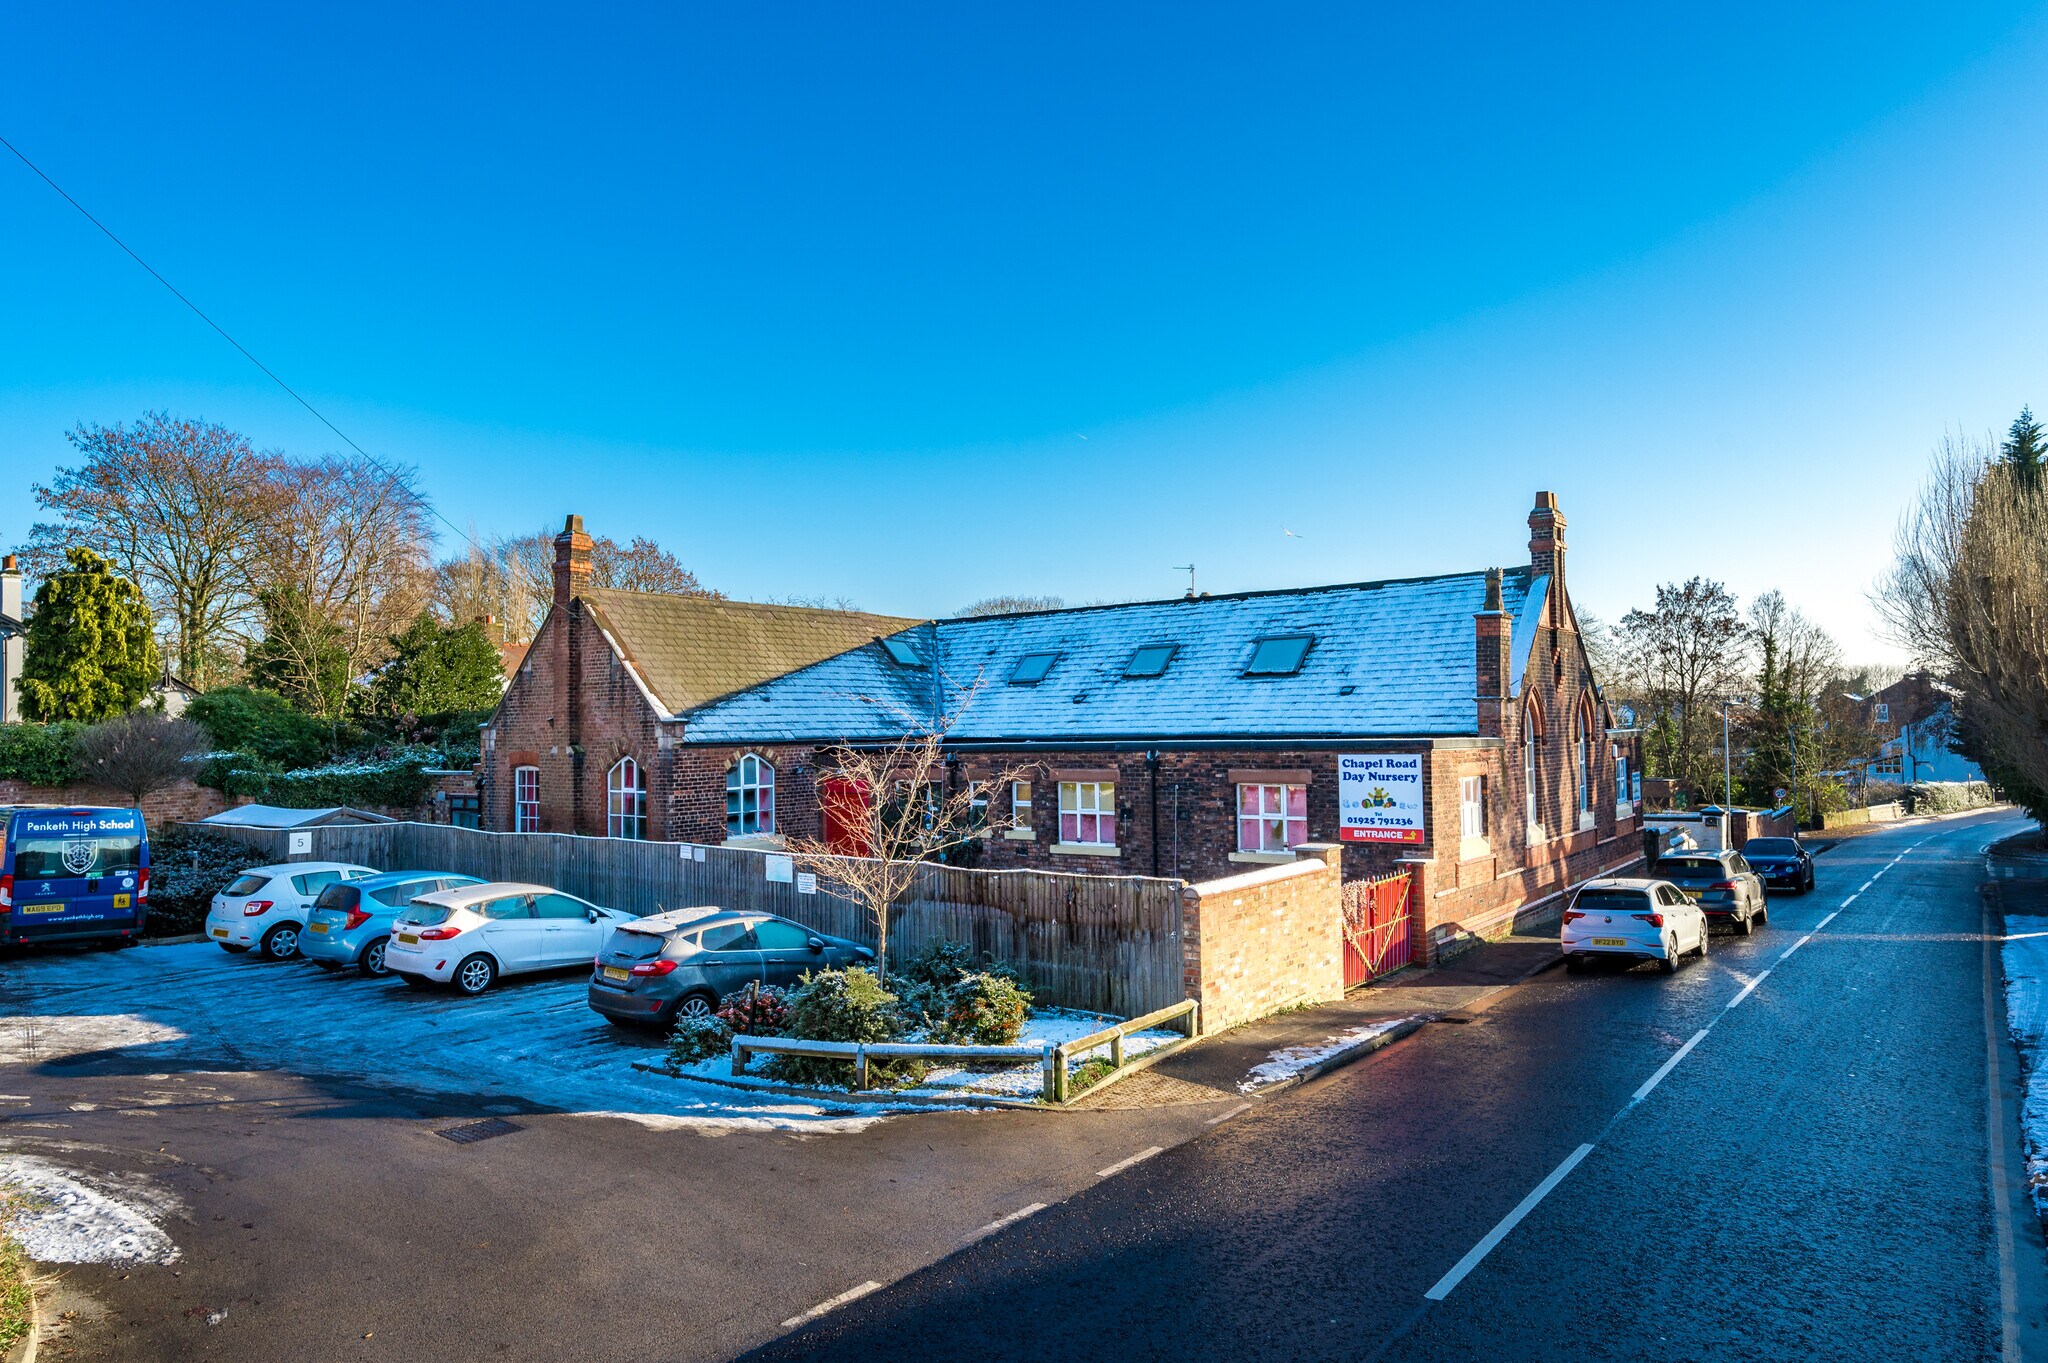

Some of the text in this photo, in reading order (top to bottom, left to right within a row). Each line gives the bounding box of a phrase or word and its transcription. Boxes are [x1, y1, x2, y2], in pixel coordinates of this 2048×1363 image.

[1342, 759, 1417, 770] Chapel Road
[1342, 772, 1418, 783] Day Nursery
[27, 819, 134, 832] Penketh High School
[1347, 817, 1413, 826] 01925 791236
[1353, 830, 1403, 839] ENTRANCE
[297, 838, 304, 847] 5
